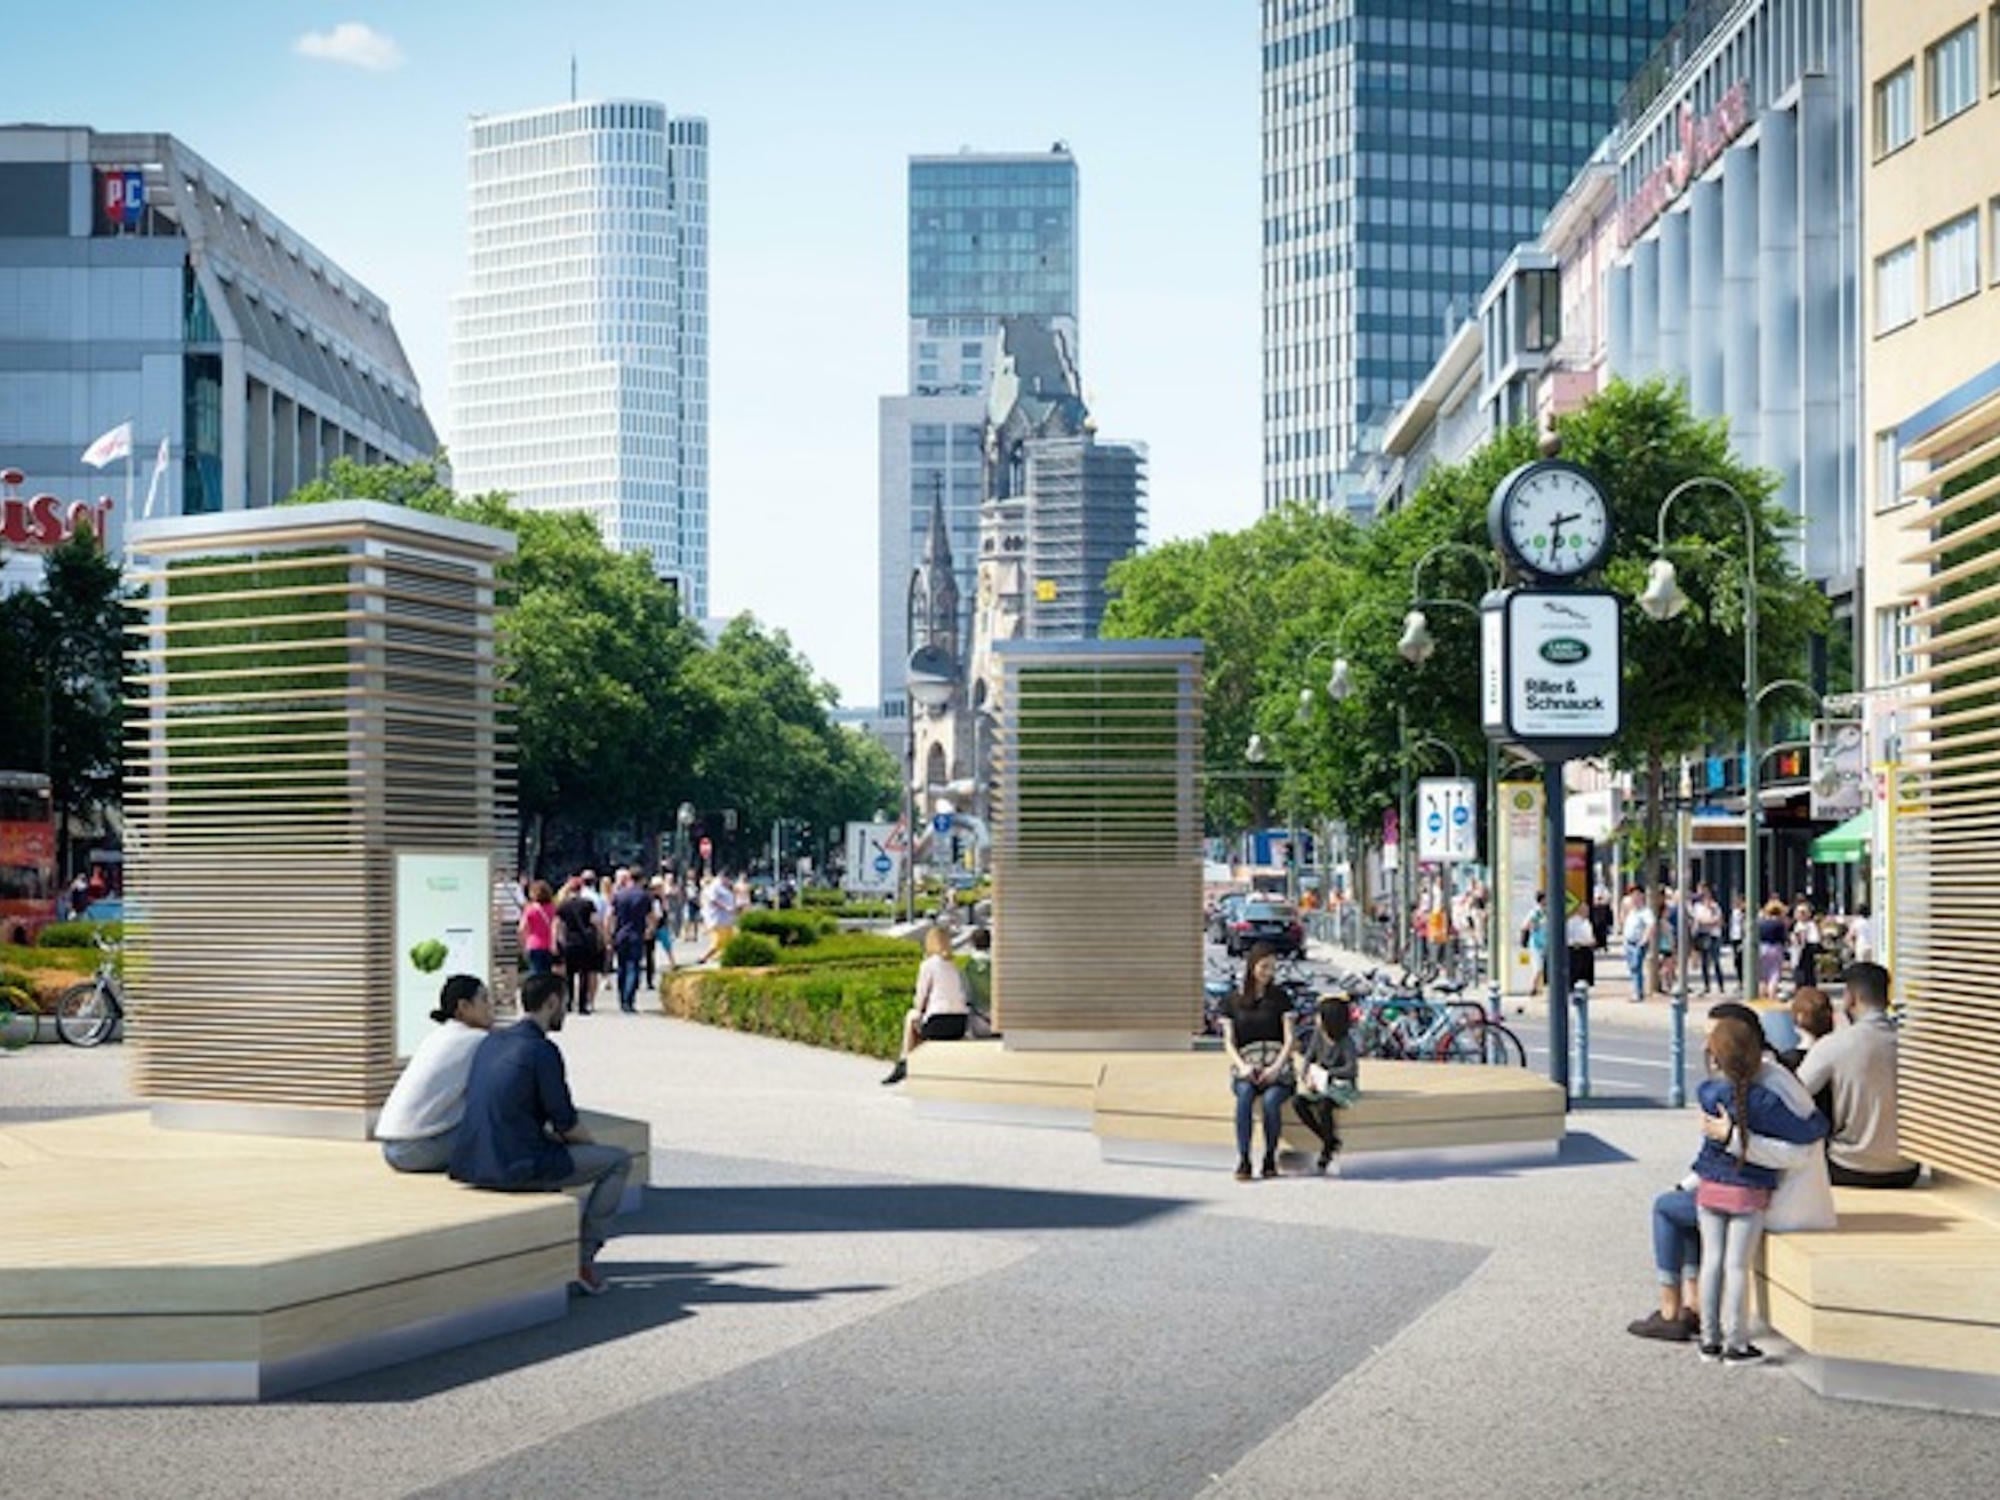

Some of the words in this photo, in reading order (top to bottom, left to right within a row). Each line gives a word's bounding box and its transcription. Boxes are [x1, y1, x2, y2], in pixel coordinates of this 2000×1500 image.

[1525, 678, 1563, 694] Riller
[1565, 678, 1577, 694] &
[1526, 695, 1605, 711] Schnauck
